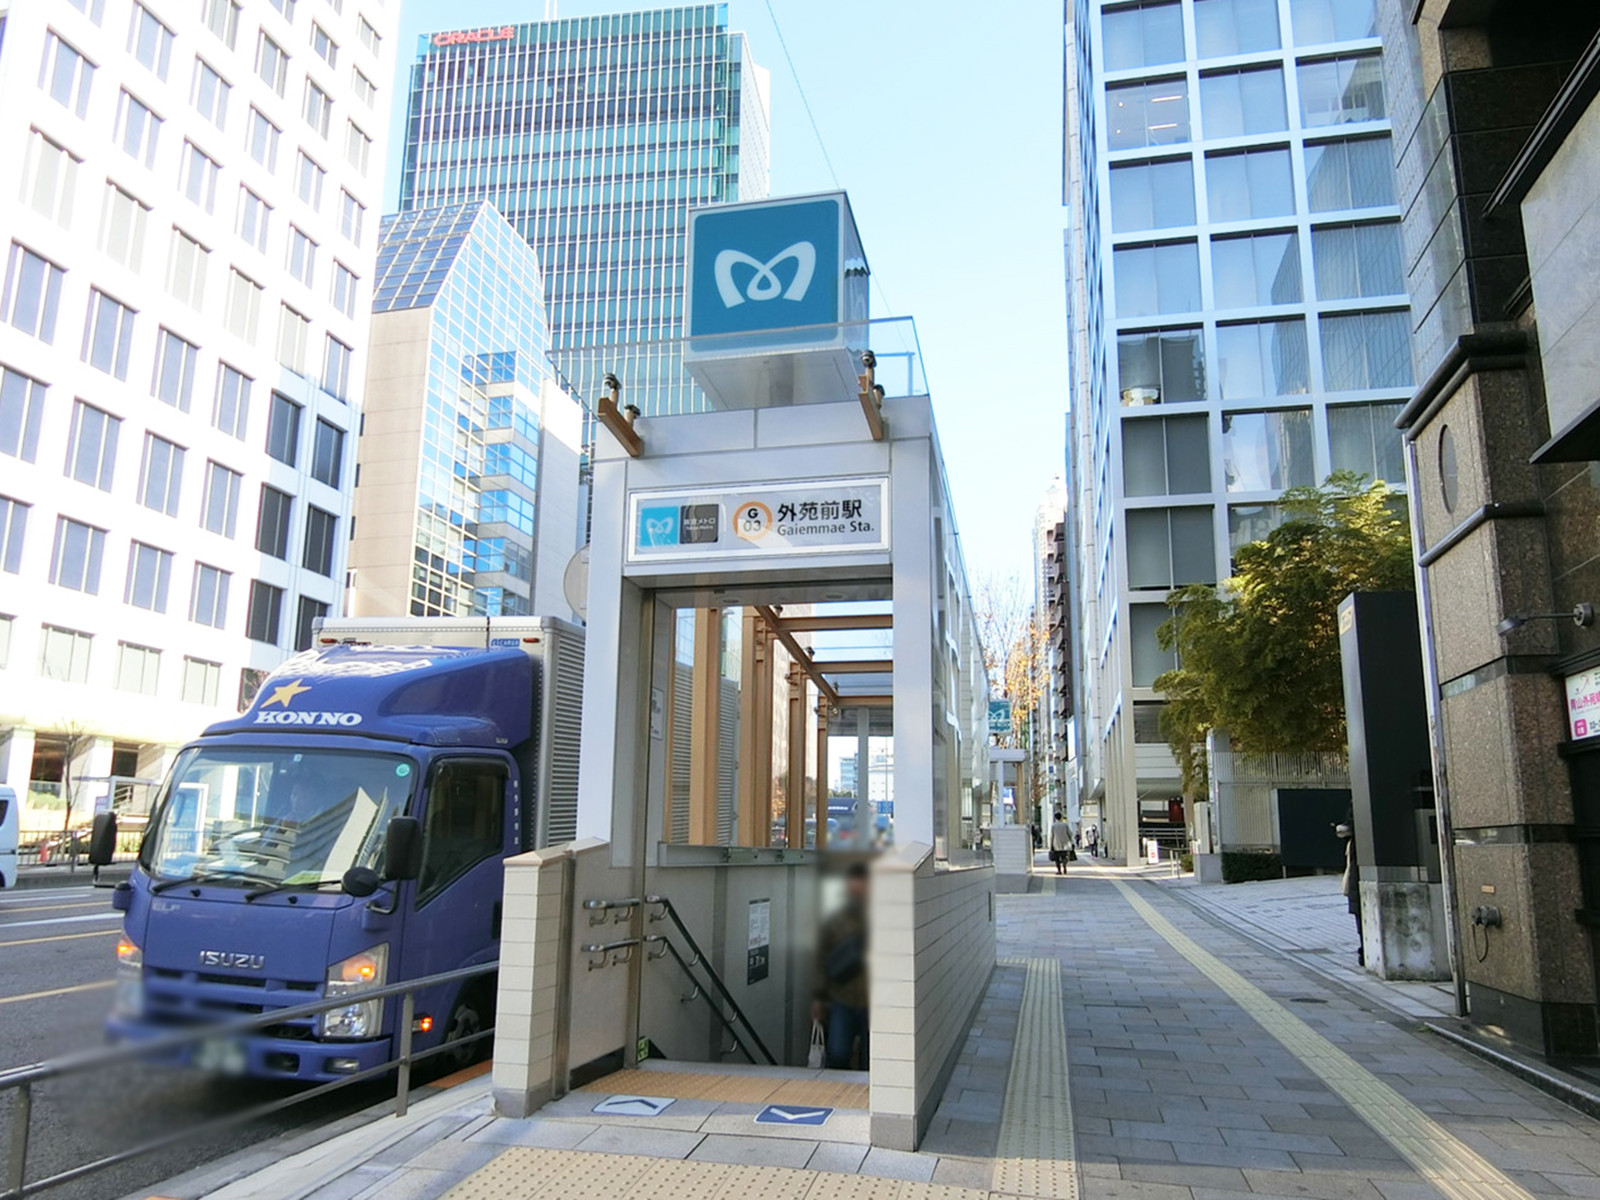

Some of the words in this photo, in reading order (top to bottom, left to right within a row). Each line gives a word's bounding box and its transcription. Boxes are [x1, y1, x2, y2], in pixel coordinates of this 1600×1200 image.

[433, 26, 515, 47] ORACLE
[747, 507, 759, 519] G
[777, 499, 862, 522] 外苑前駅
[743, 519, 761, 532] 03
[777, 523, 845, 537] Gaiemmae
[850, 519, 875, 533] Sta.
[253, 711, 363, 726] KONNO
[199, 950, 265, 970] ISUZU
